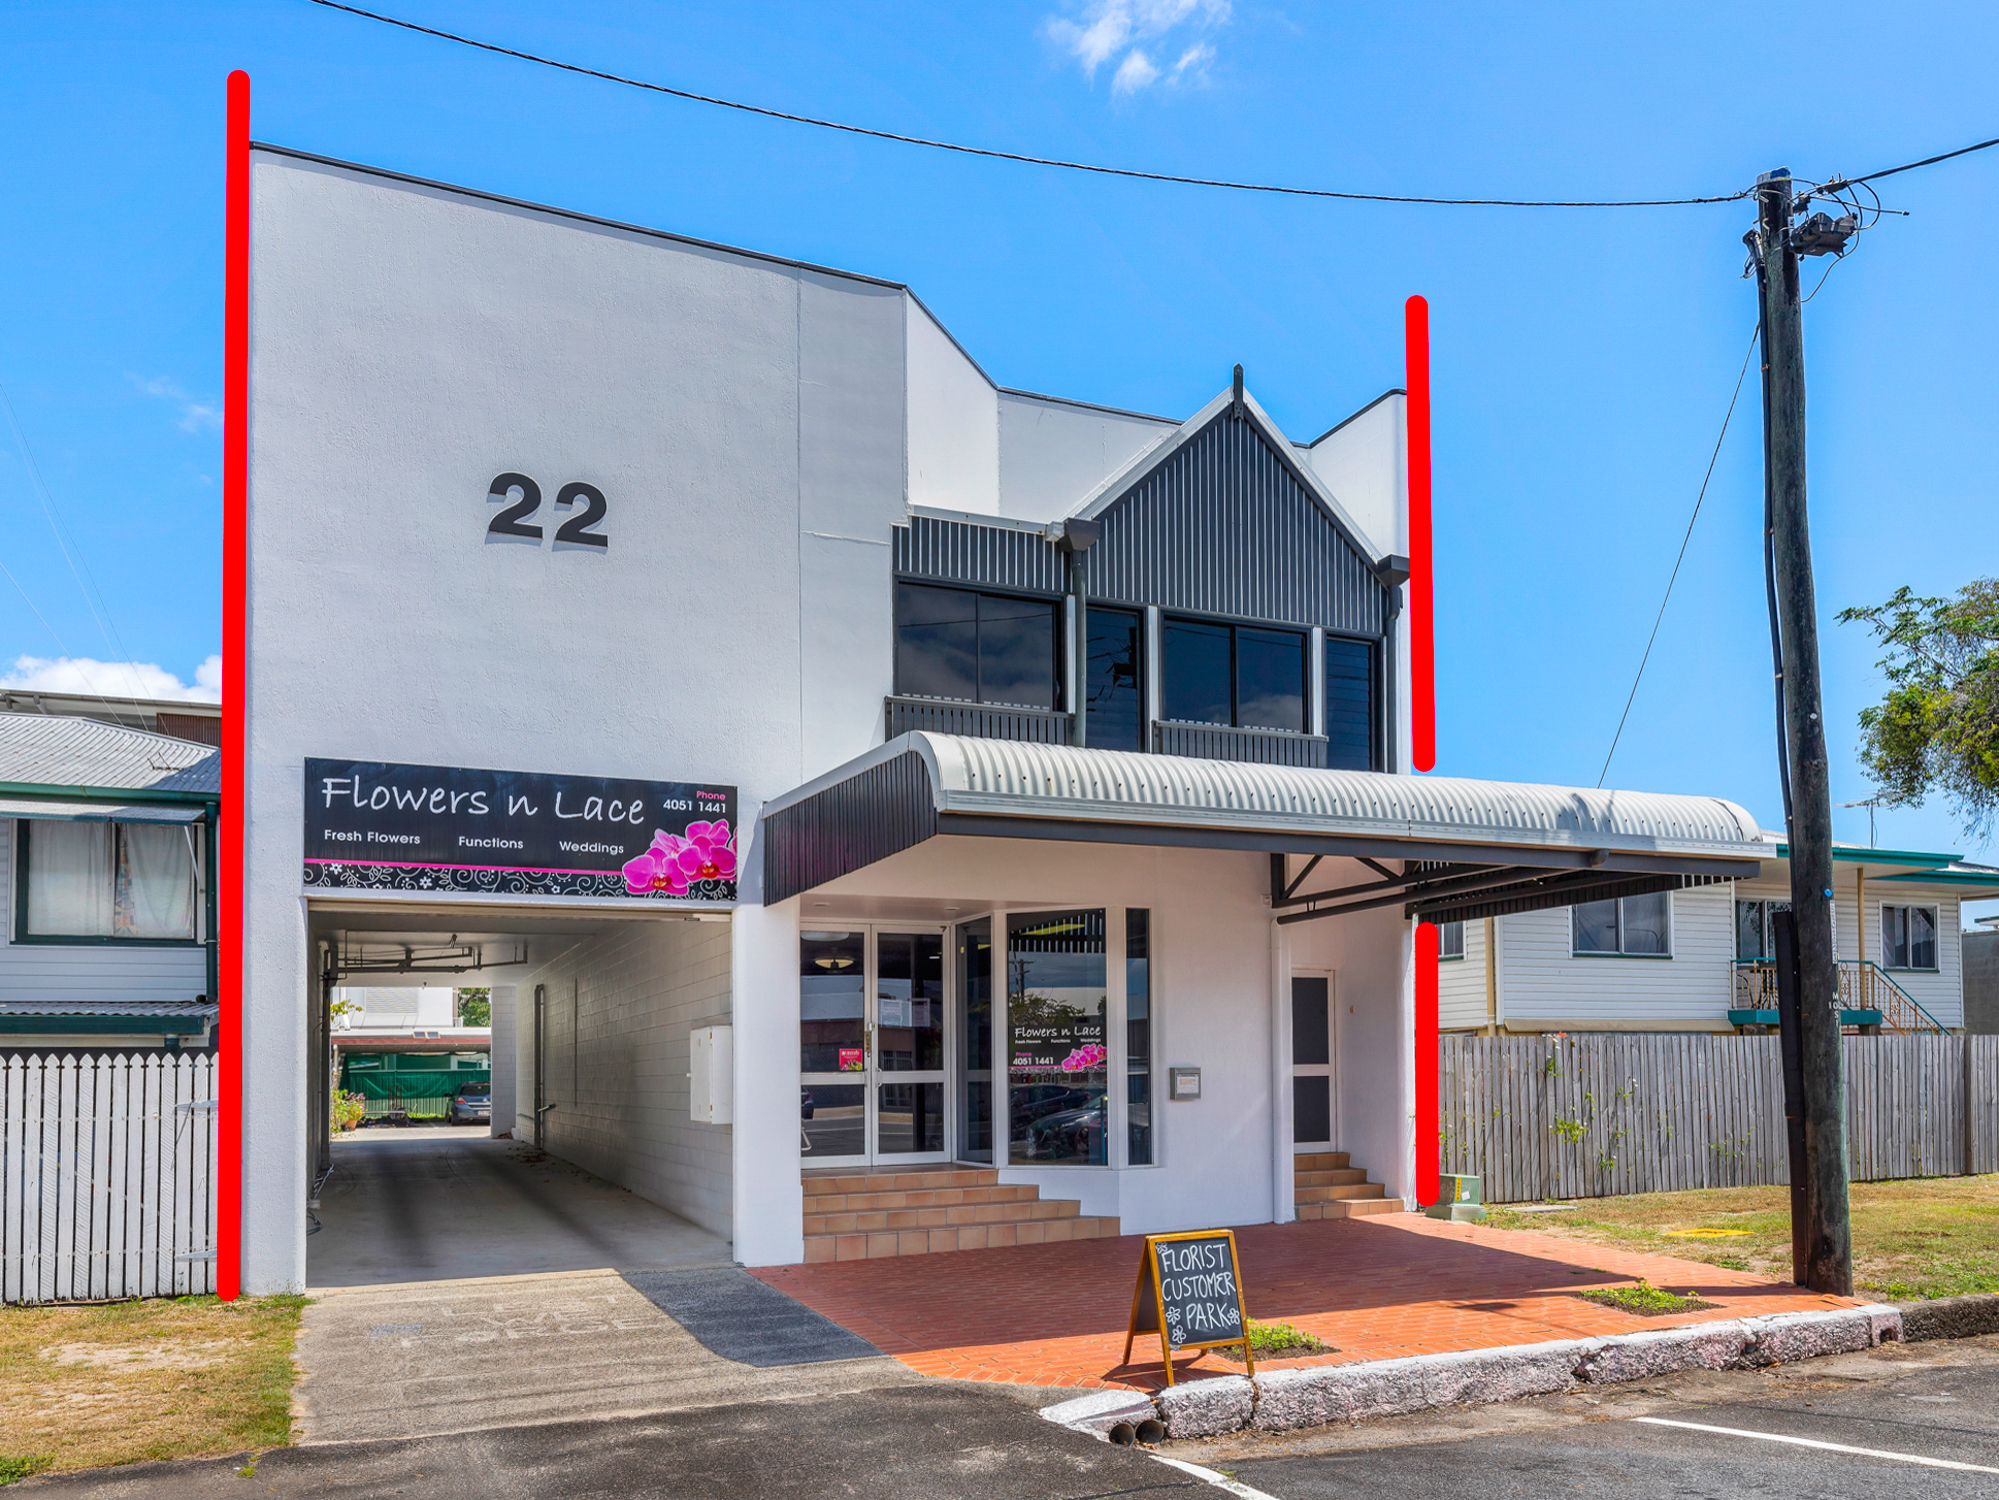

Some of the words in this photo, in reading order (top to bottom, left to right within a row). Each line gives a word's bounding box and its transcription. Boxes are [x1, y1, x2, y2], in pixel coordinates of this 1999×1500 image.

[488, 472, 609, 548] 22
[321, 774, 490, 815] Flowers
[507, 794, 539, 817] n
[554, 790, 646, 825] Lace
[696, 790, 726, 801] Phone
[662, 799, 693, 812] 4051
[698, 801, 727, 814] 1441
[324, 829, 362, 843] Fresh
[366, 831, 421, 845] Flowers
[458, 836, 524, 850] Functions
[559, 841, 624, 854] Weddings
[1014, 1026, 1058, 1038] Flowers
[1061, 1028, 1071, 1036] n
[1074, 1026, 1102, 1036] Lace
[1013, 1057, 1032, 1065] 4051
[1035, 1056, 1054, 1065] 1441
[1161, 1243, 1226, 1273] FLORIST
[1162, 1271, 1236, 1301] CUSTOMER
[1185, 1302, 1232, 1330] PARK
